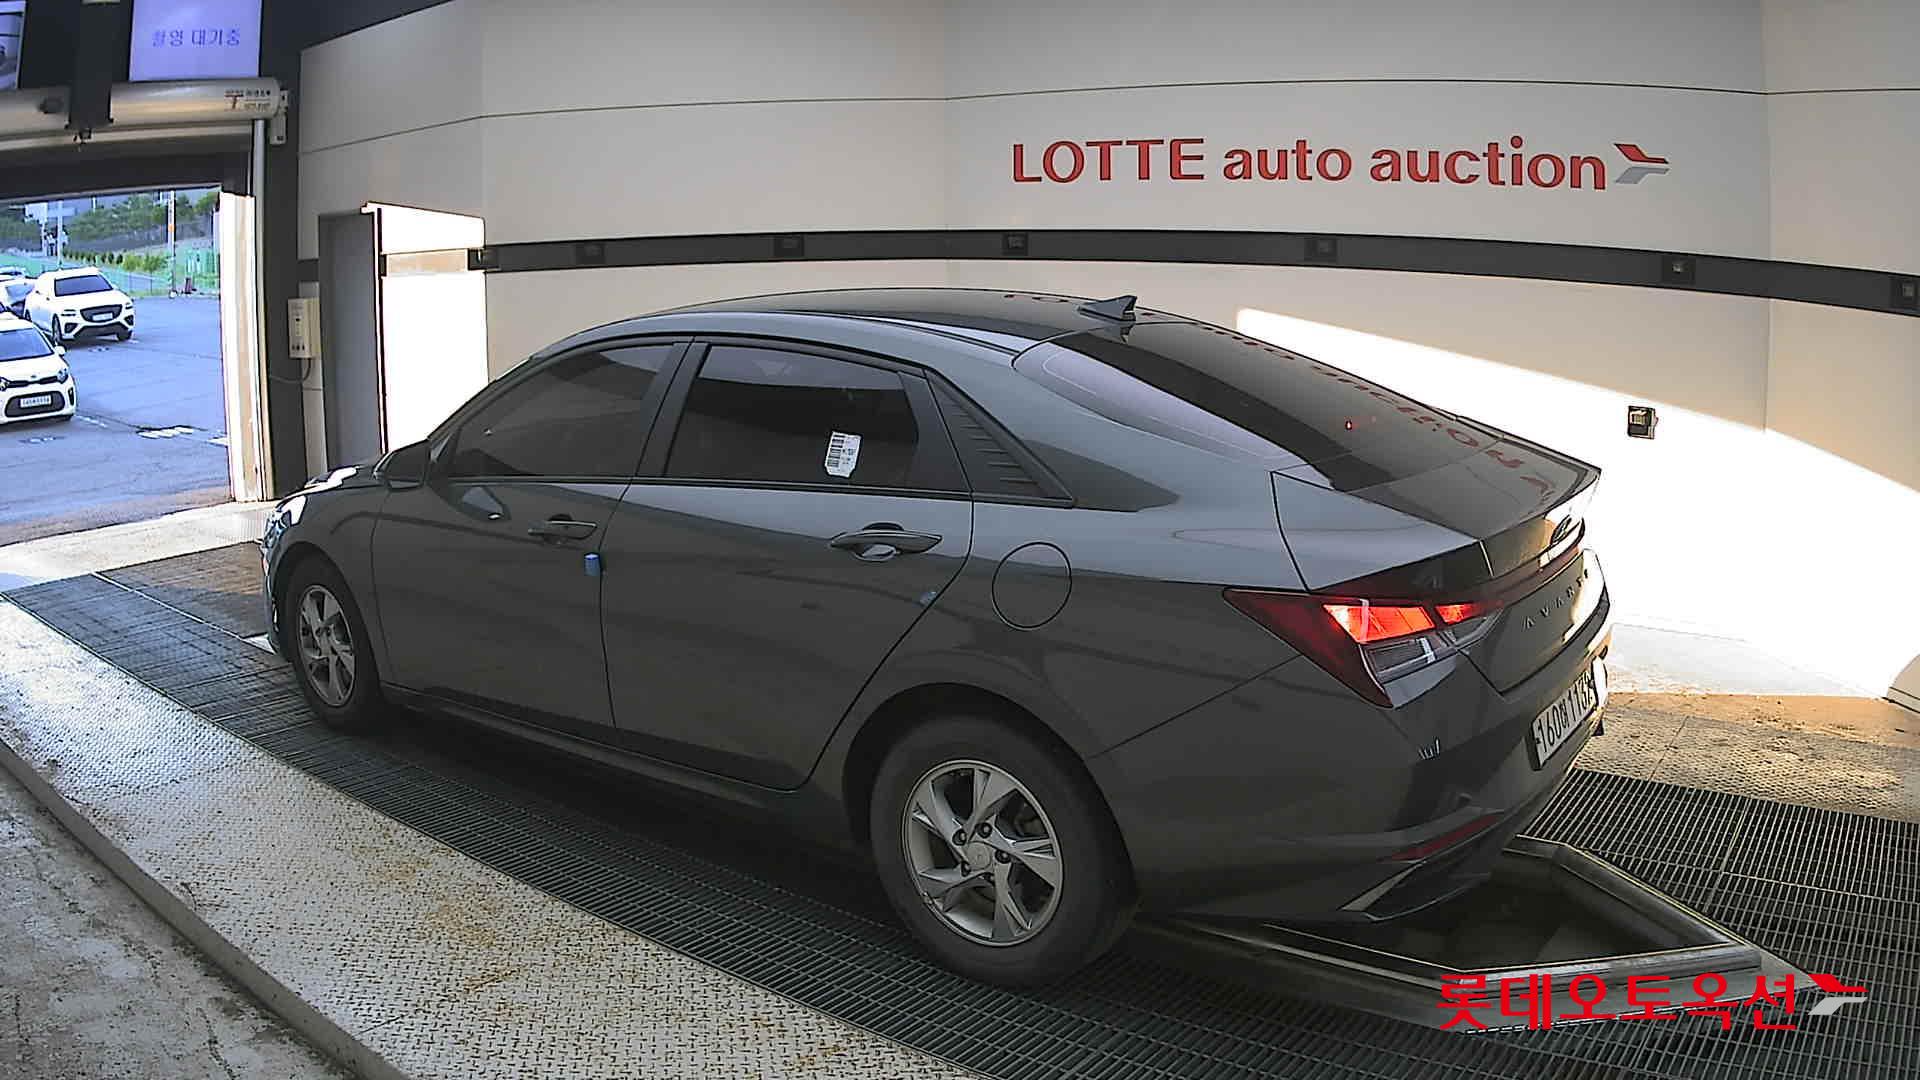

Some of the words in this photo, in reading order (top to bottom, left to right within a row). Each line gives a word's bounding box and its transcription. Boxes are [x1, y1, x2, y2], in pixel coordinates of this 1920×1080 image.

[191, 27, 241, 48] 대기중
[1013, 138, 1205, 183] LOTTE
[1224, 139, 1354, 182] auto
[1369, 136, 1606, 190] auction
